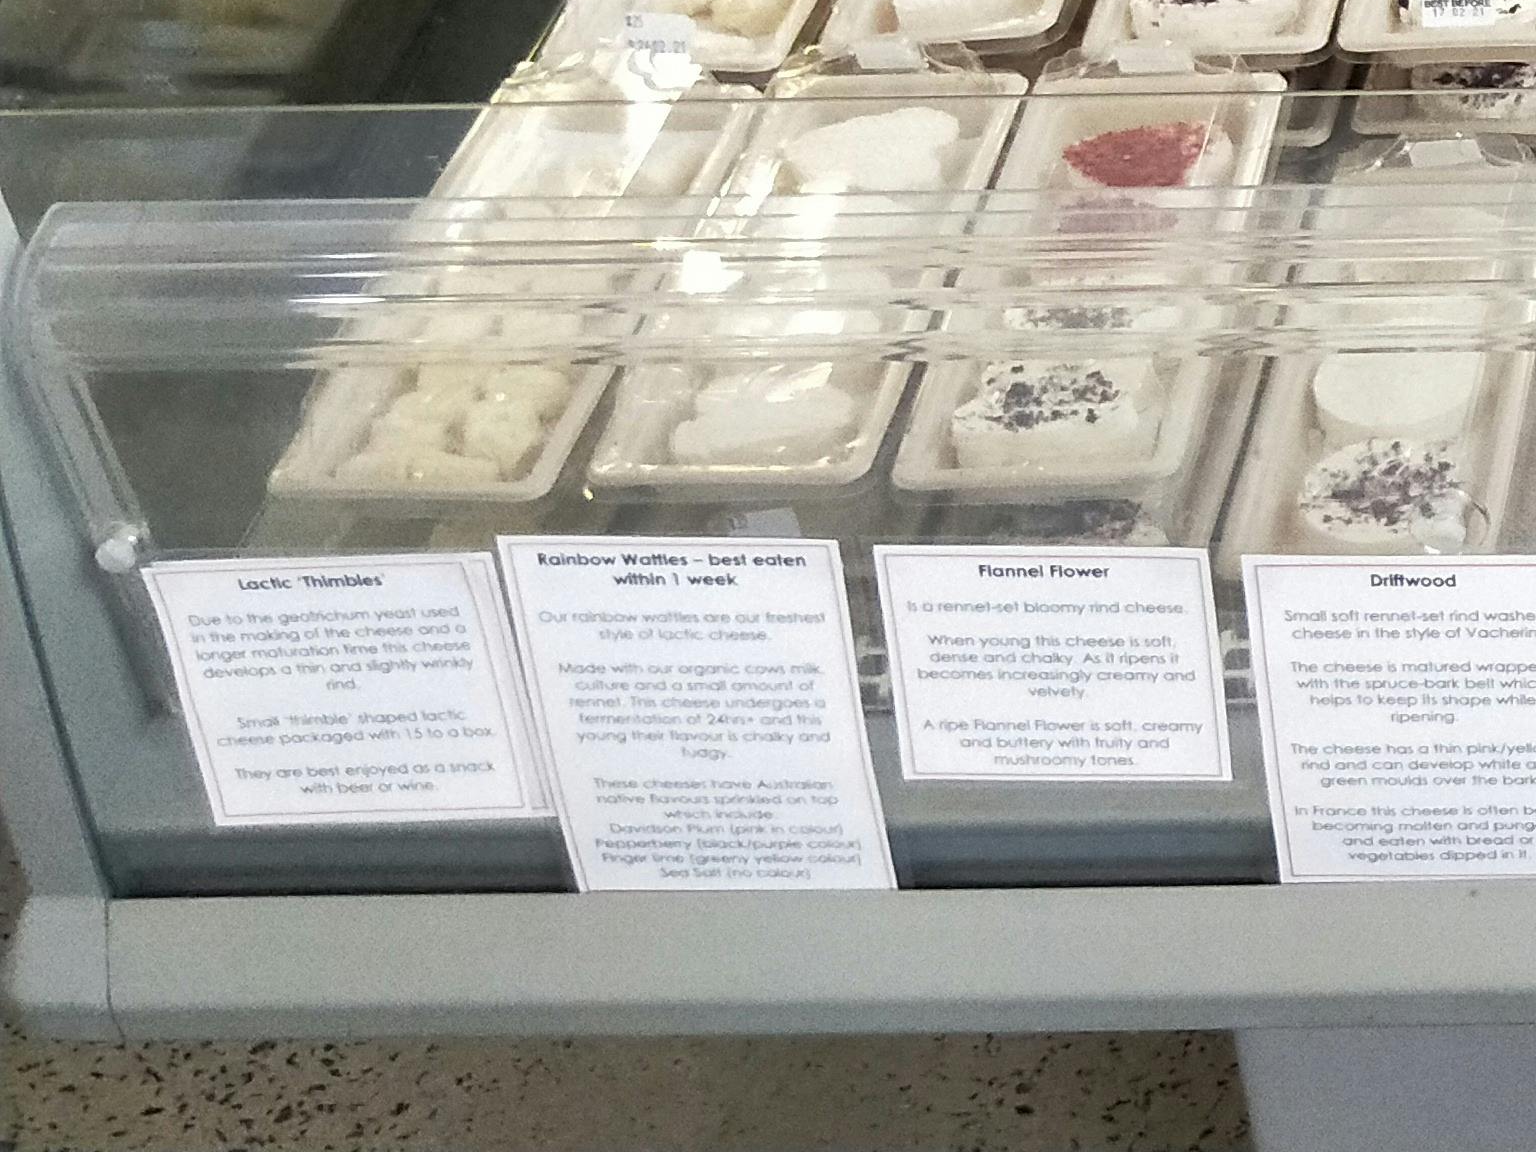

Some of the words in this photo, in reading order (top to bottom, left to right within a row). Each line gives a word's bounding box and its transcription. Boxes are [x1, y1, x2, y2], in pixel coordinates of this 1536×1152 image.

[1424, 0, 1449, 8] BEST
[536, 552, 616, 566] Rainbow
[620, 552, 688, 568] Wattles
[707, 552, 747, 569] best
[751, 553, 807, 567] eaten
[977, 563, 1044, 578] Flannel
[1048, 564, 1109, 578] Flower
[237, 576, 293, 591] Lactic
[612, 571, 667, 586] within
[671, 571, 679, 586] 1
[686, 572, 738, 586] week
[1369, 573, 1457, 587] Driftwood
